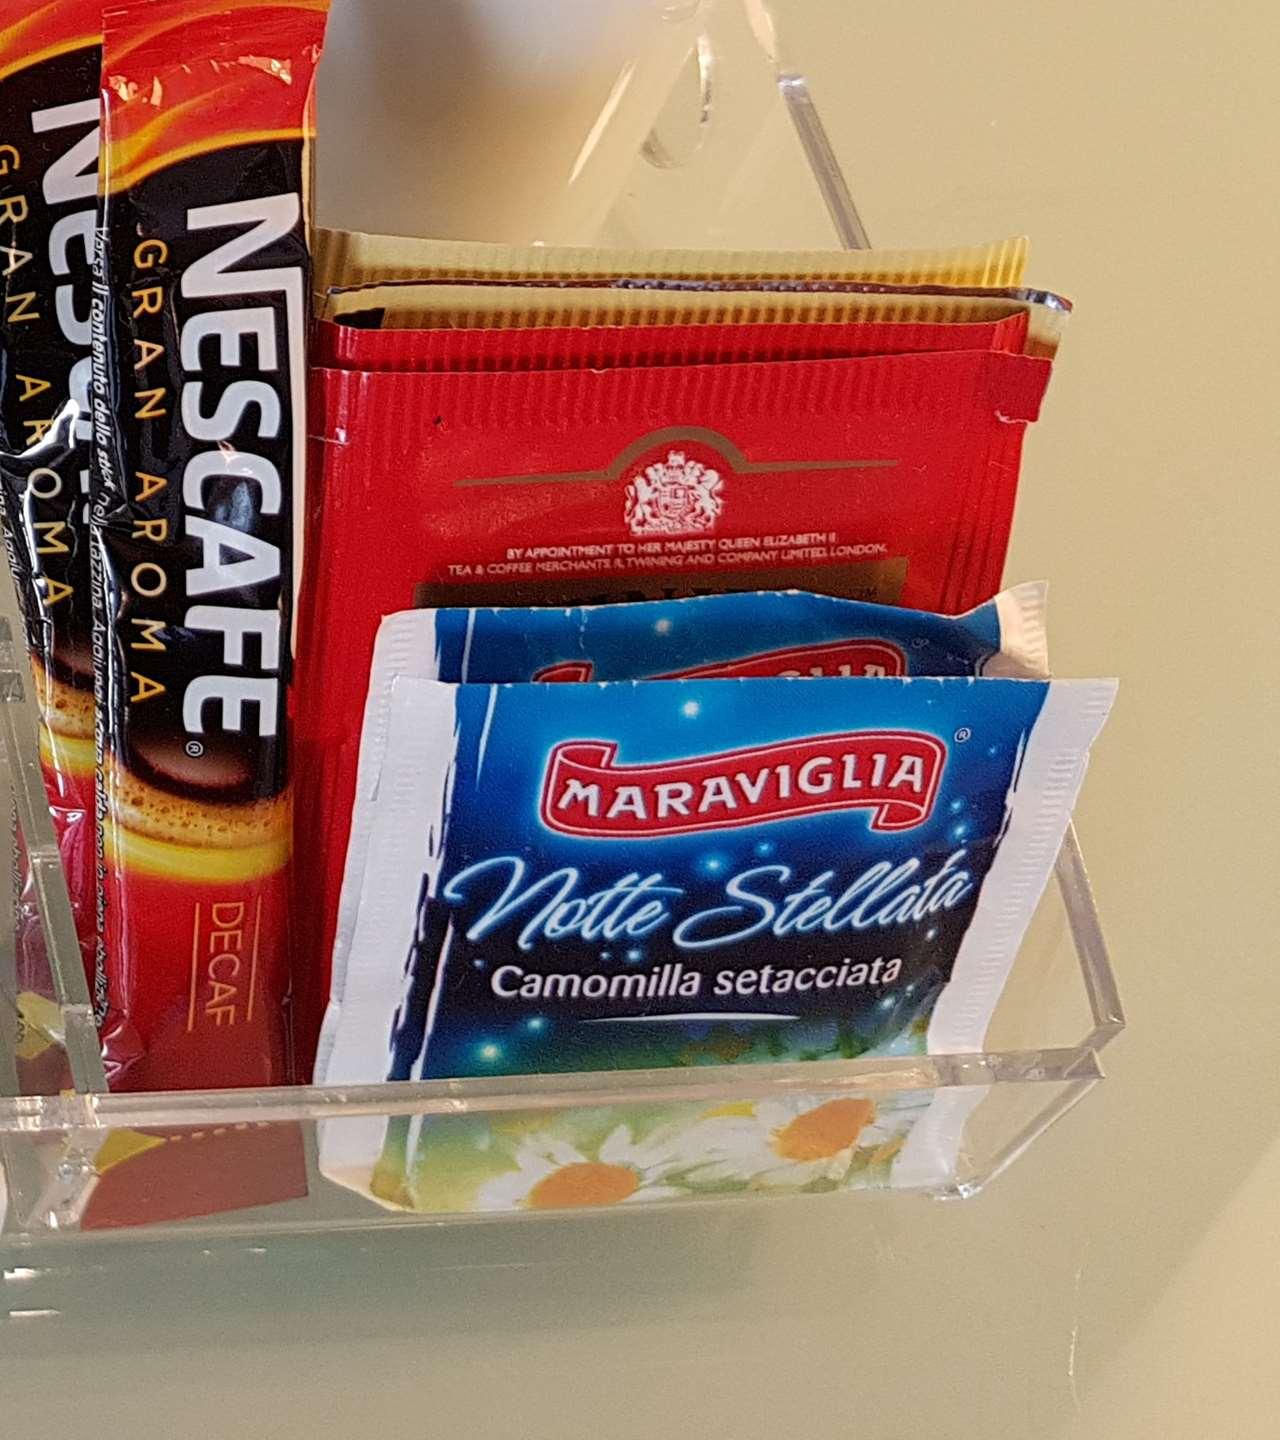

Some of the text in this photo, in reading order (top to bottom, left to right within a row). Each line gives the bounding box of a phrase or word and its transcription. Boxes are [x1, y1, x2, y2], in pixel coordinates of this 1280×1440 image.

[90, 297, 108, 394] contenuto
[92, 398, 110, 444] dello
[16, 373, 75, 607] AROMA
[95, 447, 115, 491] stick
[130, 238, 168, 702] GRAN AROMA
[448, 564, 472, 576] TEA
[487, 561, 533, 574] COFFEE
[627, 553, 684, 568] TWINING
[687, 553, 715, 566] AND
[718, 549, 779, 564] COMPANY
[506, 548, 524, 560] BY
[525, 544, 612, 559] APPOINTMENT
[617, 543, 635, 555] TO
[637, 542, 662, 553] HER
[665, 539, 716, 552] MAJESTY
[718, 536, 760, 550] QUEEN
[763, 532, 827, 547] ELIZABETH
[557, 753, 925, 820] MARAVIGLIA
[444, 847, 973, 951] Notte Stellata
[205, 901, 246, 1027] DECAF
[490, 955, 903, 1001] Camomilla setacciata
